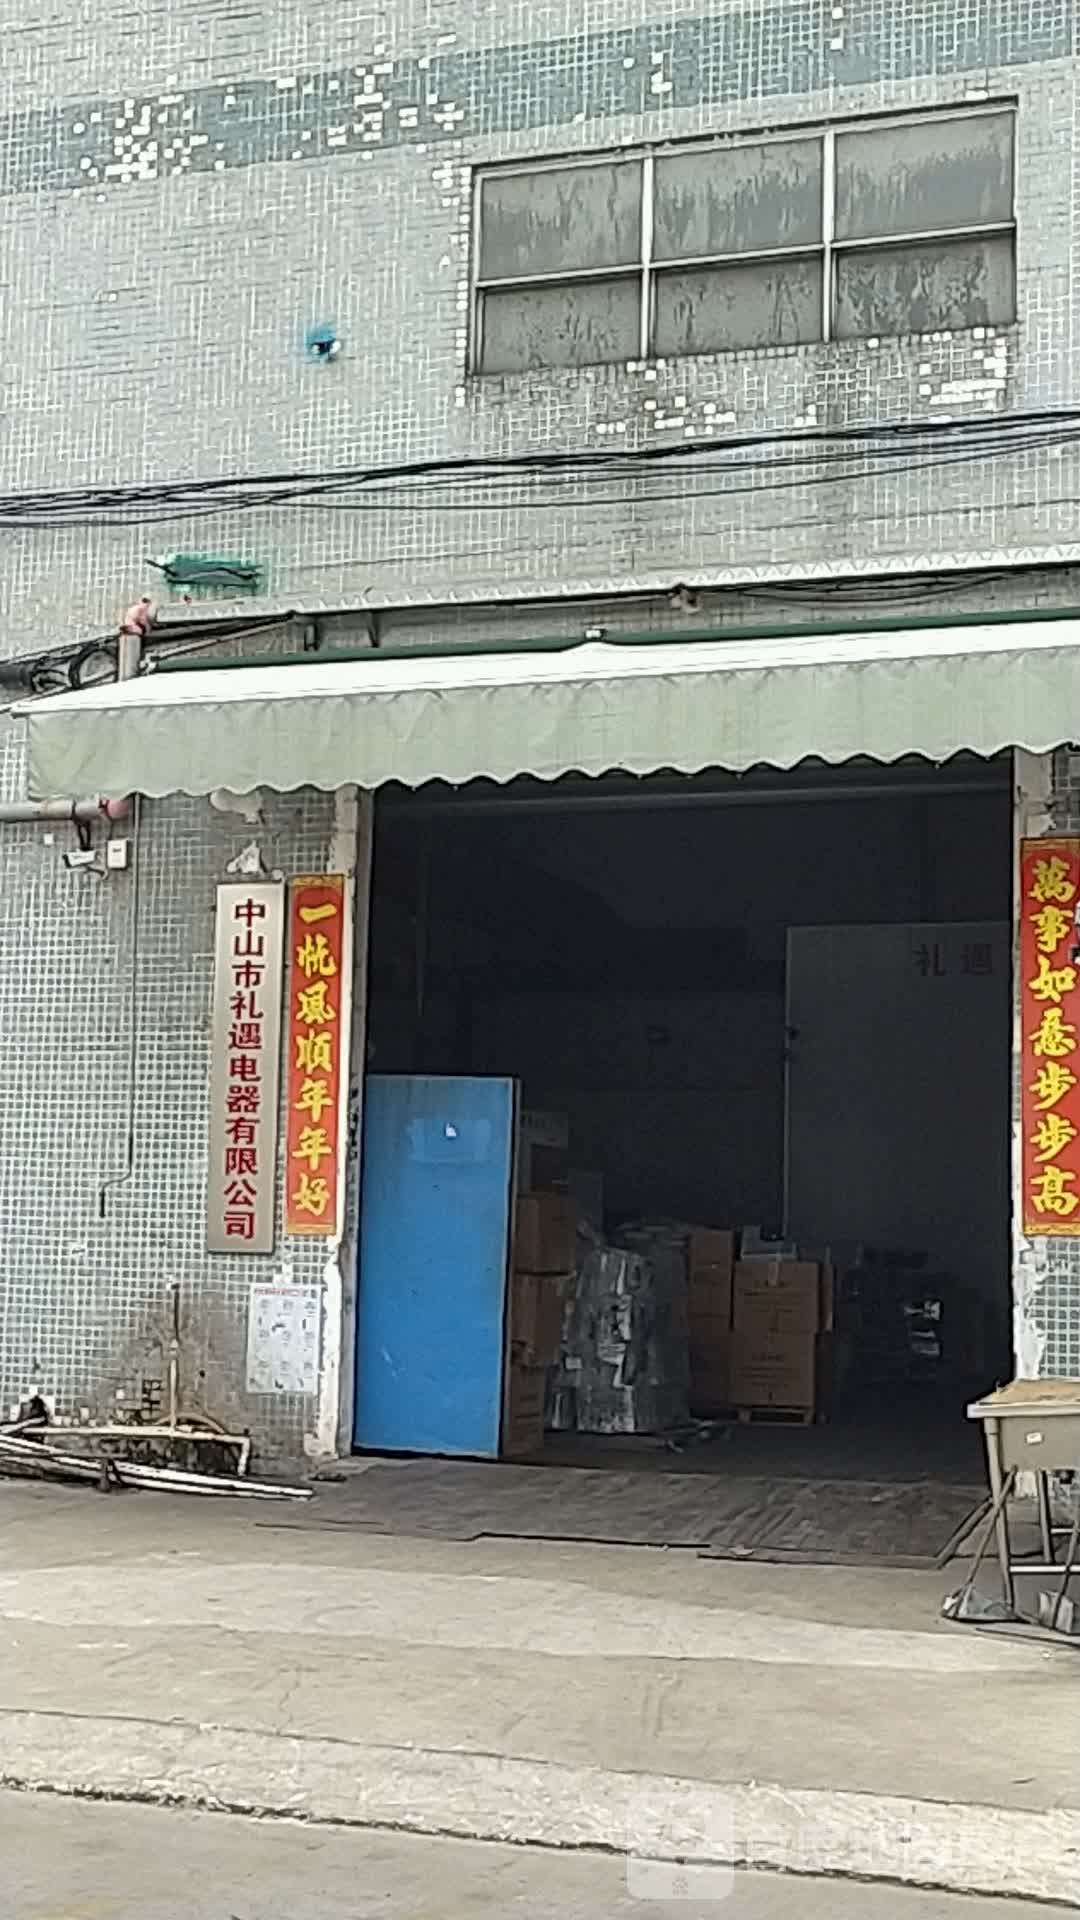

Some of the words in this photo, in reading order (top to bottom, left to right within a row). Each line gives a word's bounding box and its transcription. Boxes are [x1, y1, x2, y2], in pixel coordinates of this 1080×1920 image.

[223, 898, 265, 1239] 中山市礼遇电器有限公司
